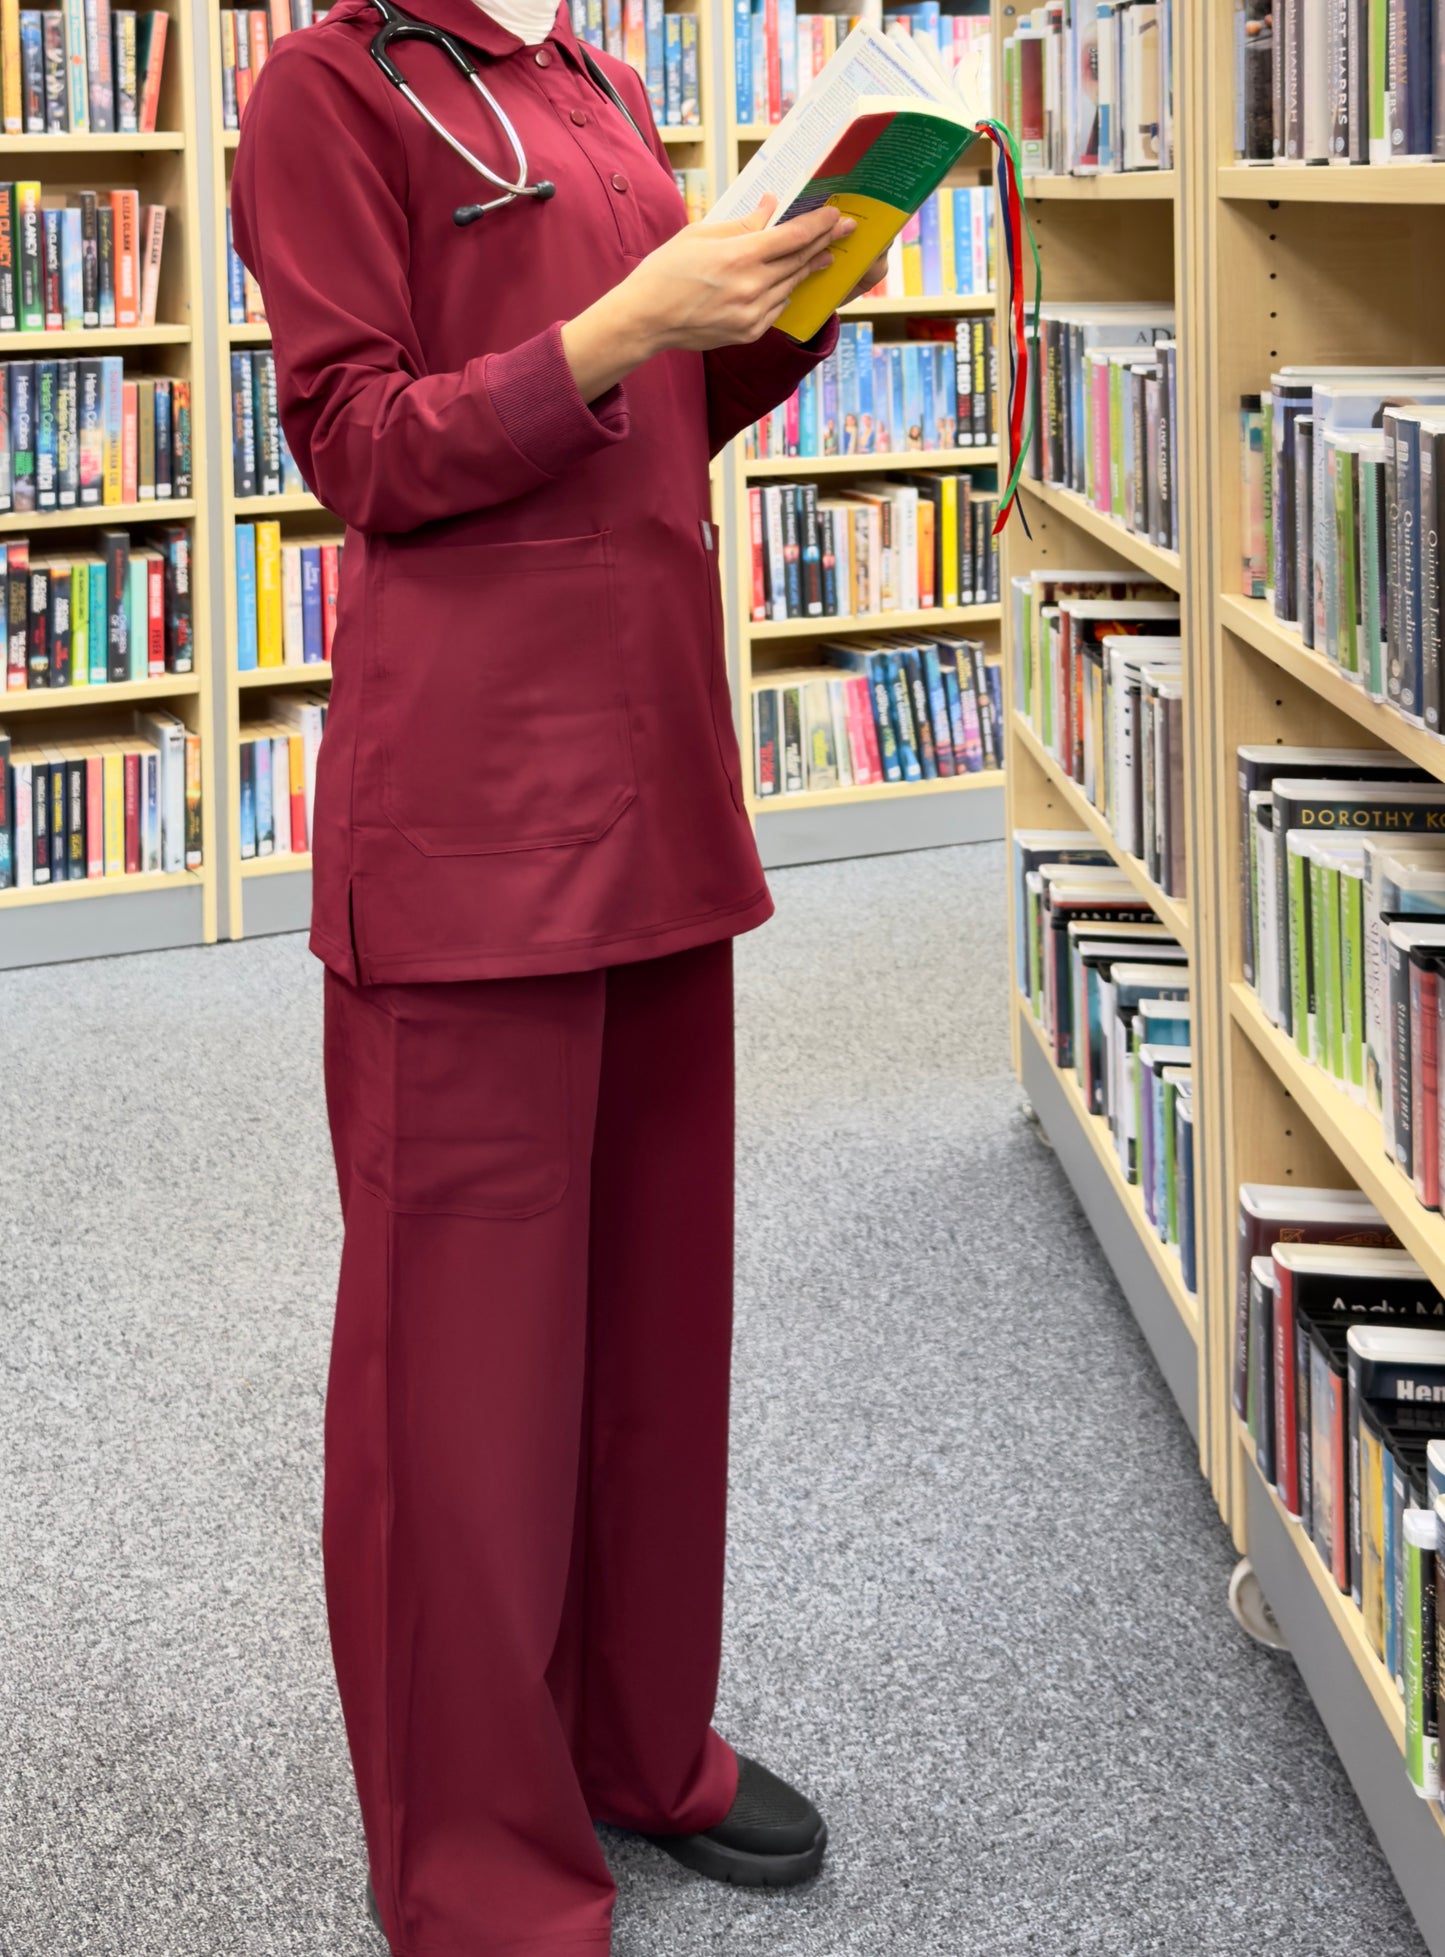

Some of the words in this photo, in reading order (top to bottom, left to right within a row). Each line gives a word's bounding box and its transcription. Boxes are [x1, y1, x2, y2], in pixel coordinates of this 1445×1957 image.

[1289, 41, 1299, 123] HANNAH
[1337, 47, 1349, 126] HARRIS
[46, 212, 57, 232] TOM
[122, 197, 131, 220] ELIZA
[25, 213, 38, 256] CLANCY
[47, 234, 58, 270] CLANCY
[123, 223, 132, 251] CLARK
[956, 322, 972, 363] CODE
[1136, 331, 1148, 343] A
[1151, 328, 1177, 347] D
[1047, 346, 1056, 367] THE
[17, 376, 29, 411] Harlan
[42, 373, 53, 410] Harlan
[86, 373, 97, 410] Harlan
[241, 356, 253, 415] JEFFERY
[266, 356, 277, 414] JEFFERY
[956, 363, 972, 395] RED
[59, 390, 70, 429] Harlan
[1047, 369, 1057, 437] CINDERELLA
[18, 414, 30, 450] Coben
[42, 412, 54, 449] Coben
[243, 417, 255, 473] DEAVER
[268, 417, 280, 472] DEAVER
[1160, 418, 1168, 453] CLIVE
[59, 431, 71, 471] Coben
[1160, 453, 1169, 502] CUSSLER
[785, 490, 795, 513] FELIX
[805, 490, 815, 513] FELIX
[786, 513, 798, 546] FRANCIS
[806, 513, 817, 545] FRANCIS
[1402, 510, 1414, 583] Quintin
[1425, 529, 1439, 599] Quintin
[1404, 587, 1417, 655] Jardine
[1429, 606, 1442, 669] Jardine
[152, 629, 162, 655] FEVER
[1301, 809, 1414, 828] DOROTHY
[1395, 1002, 1407, 1062] Stephen
[1399, 1066, 1411, 1133] LEATHER
[1277, 1325, 1286, 1362] STATE
[1278, 1365, 1287, 1387] OF
[1396, 1379, 1445, 1402] Hen
